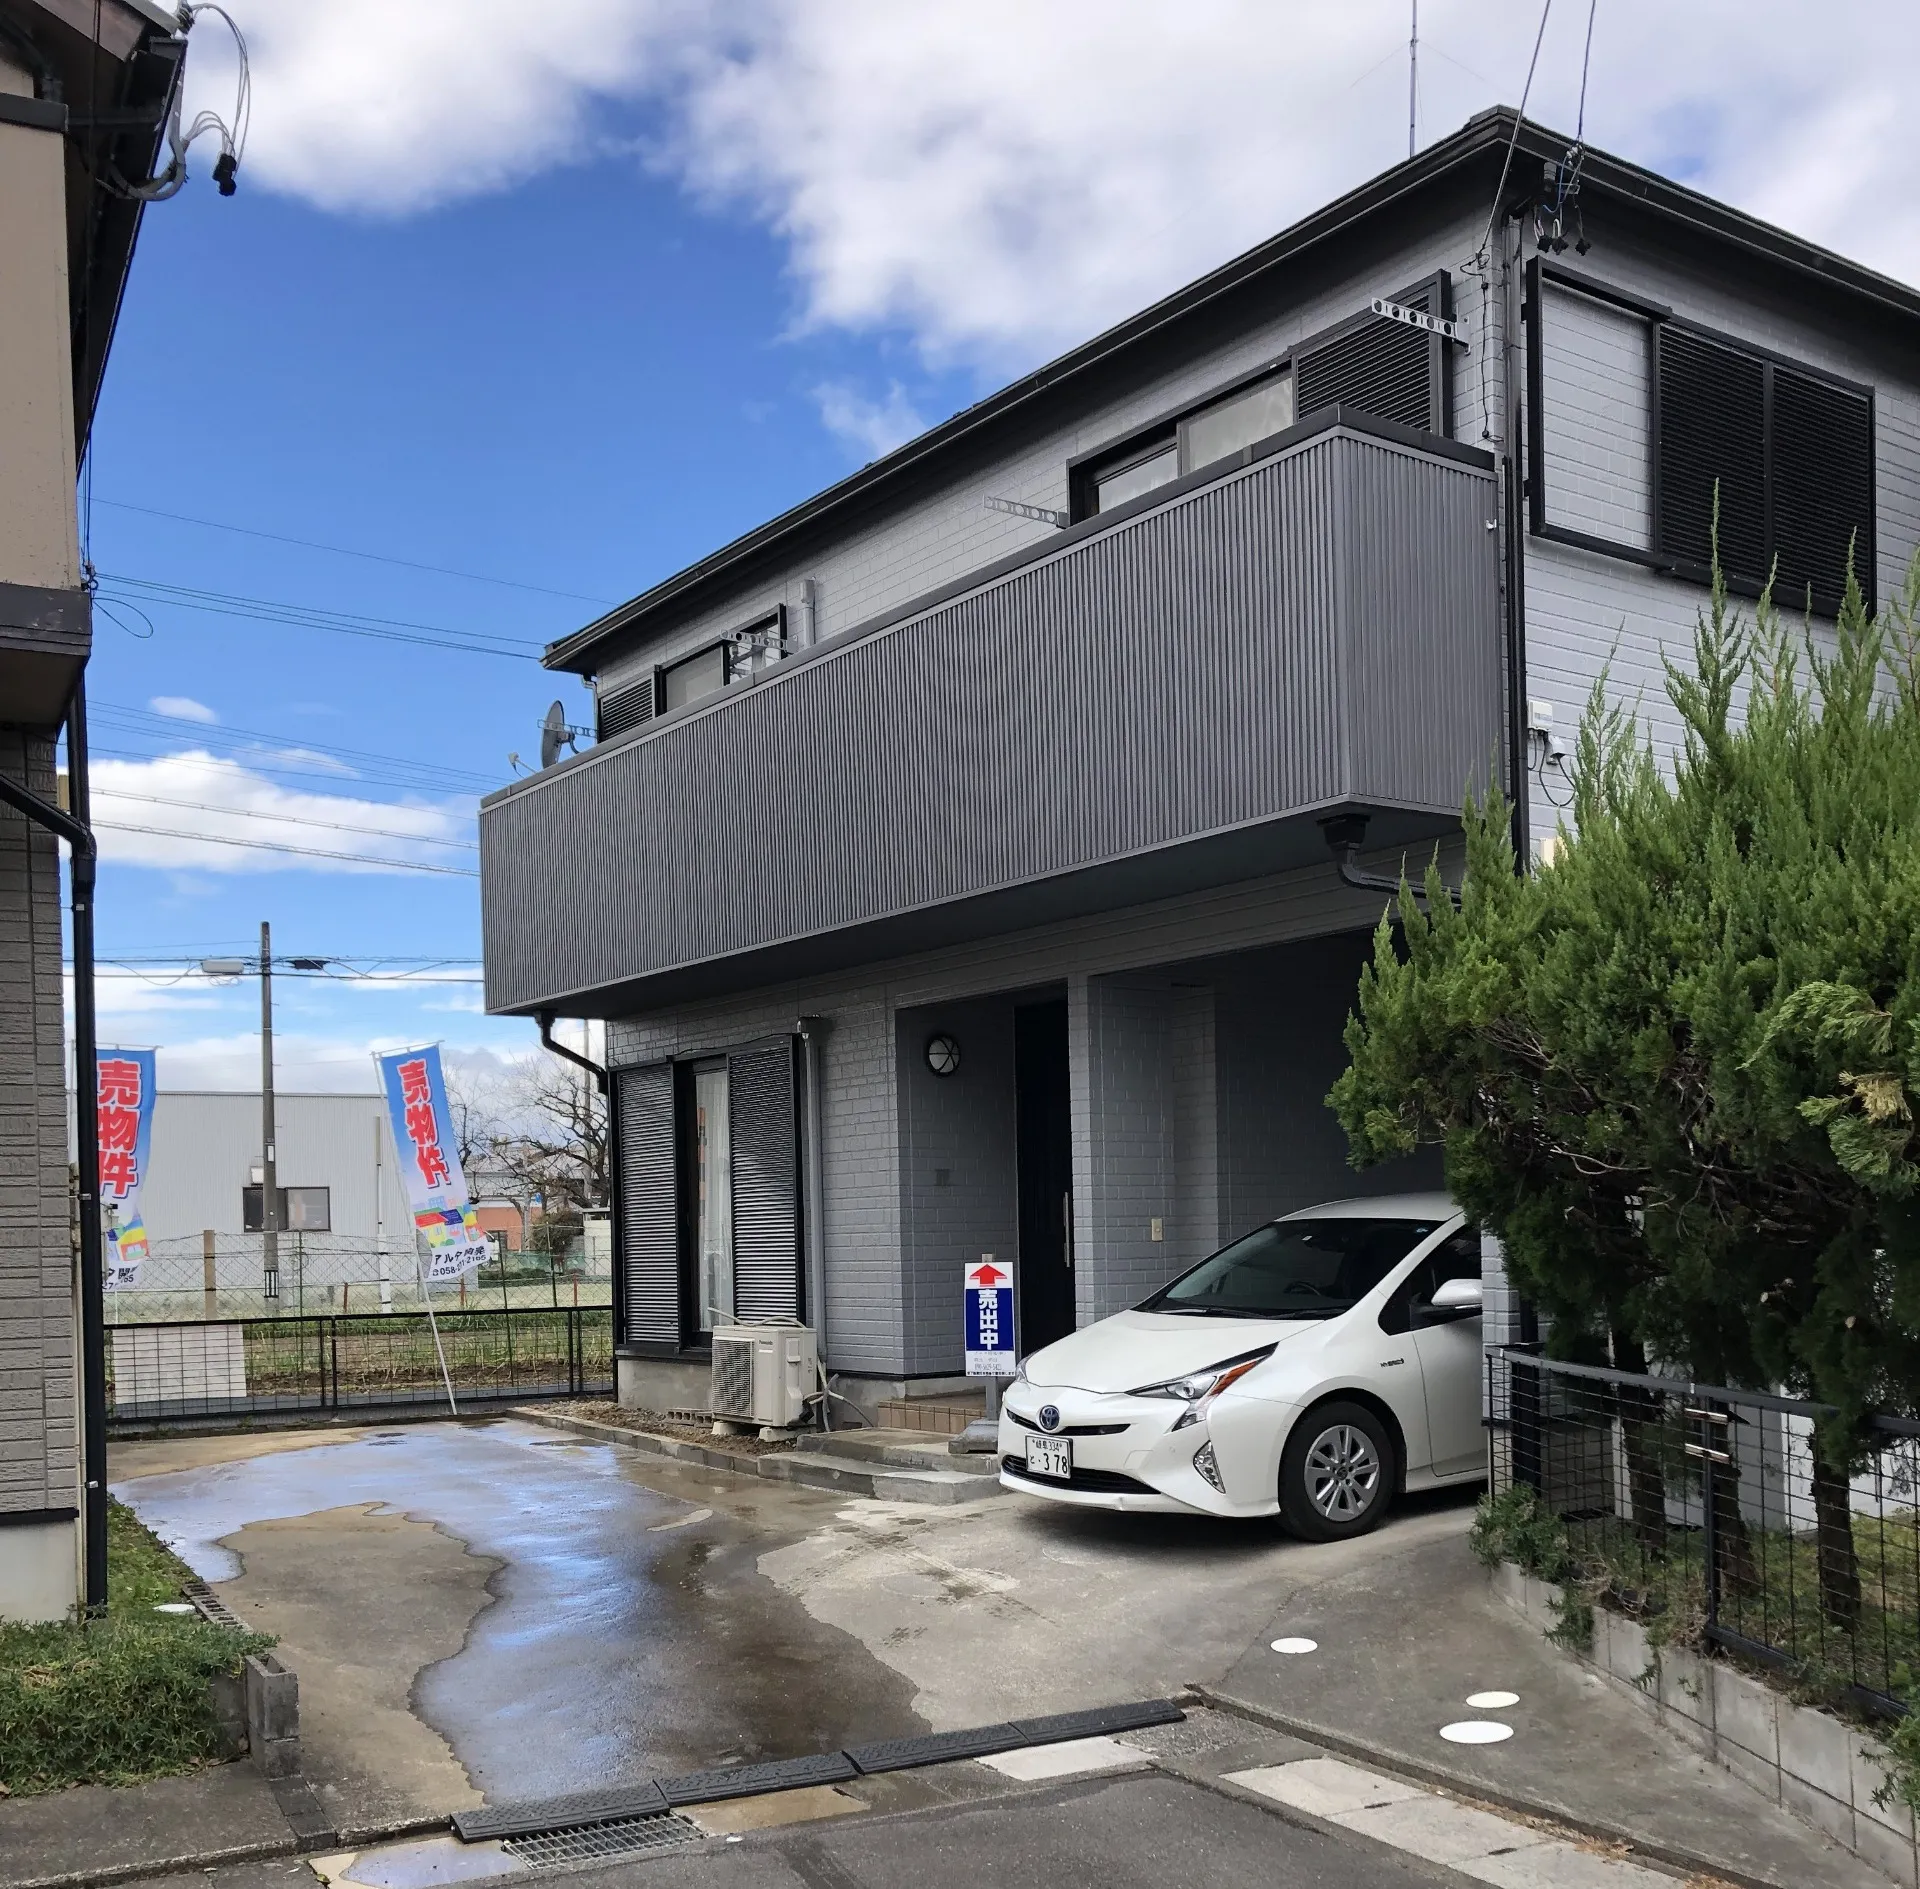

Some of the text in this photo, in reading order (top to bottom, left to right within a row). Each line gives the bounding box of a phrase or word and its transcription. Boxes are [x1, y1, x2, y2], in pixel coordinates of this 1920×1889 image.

[97, 1058, 141, 1198] 売物件
[399, 1058, 450, 1188] 売物件
[978, 1288, 999, 1351] 売出中
